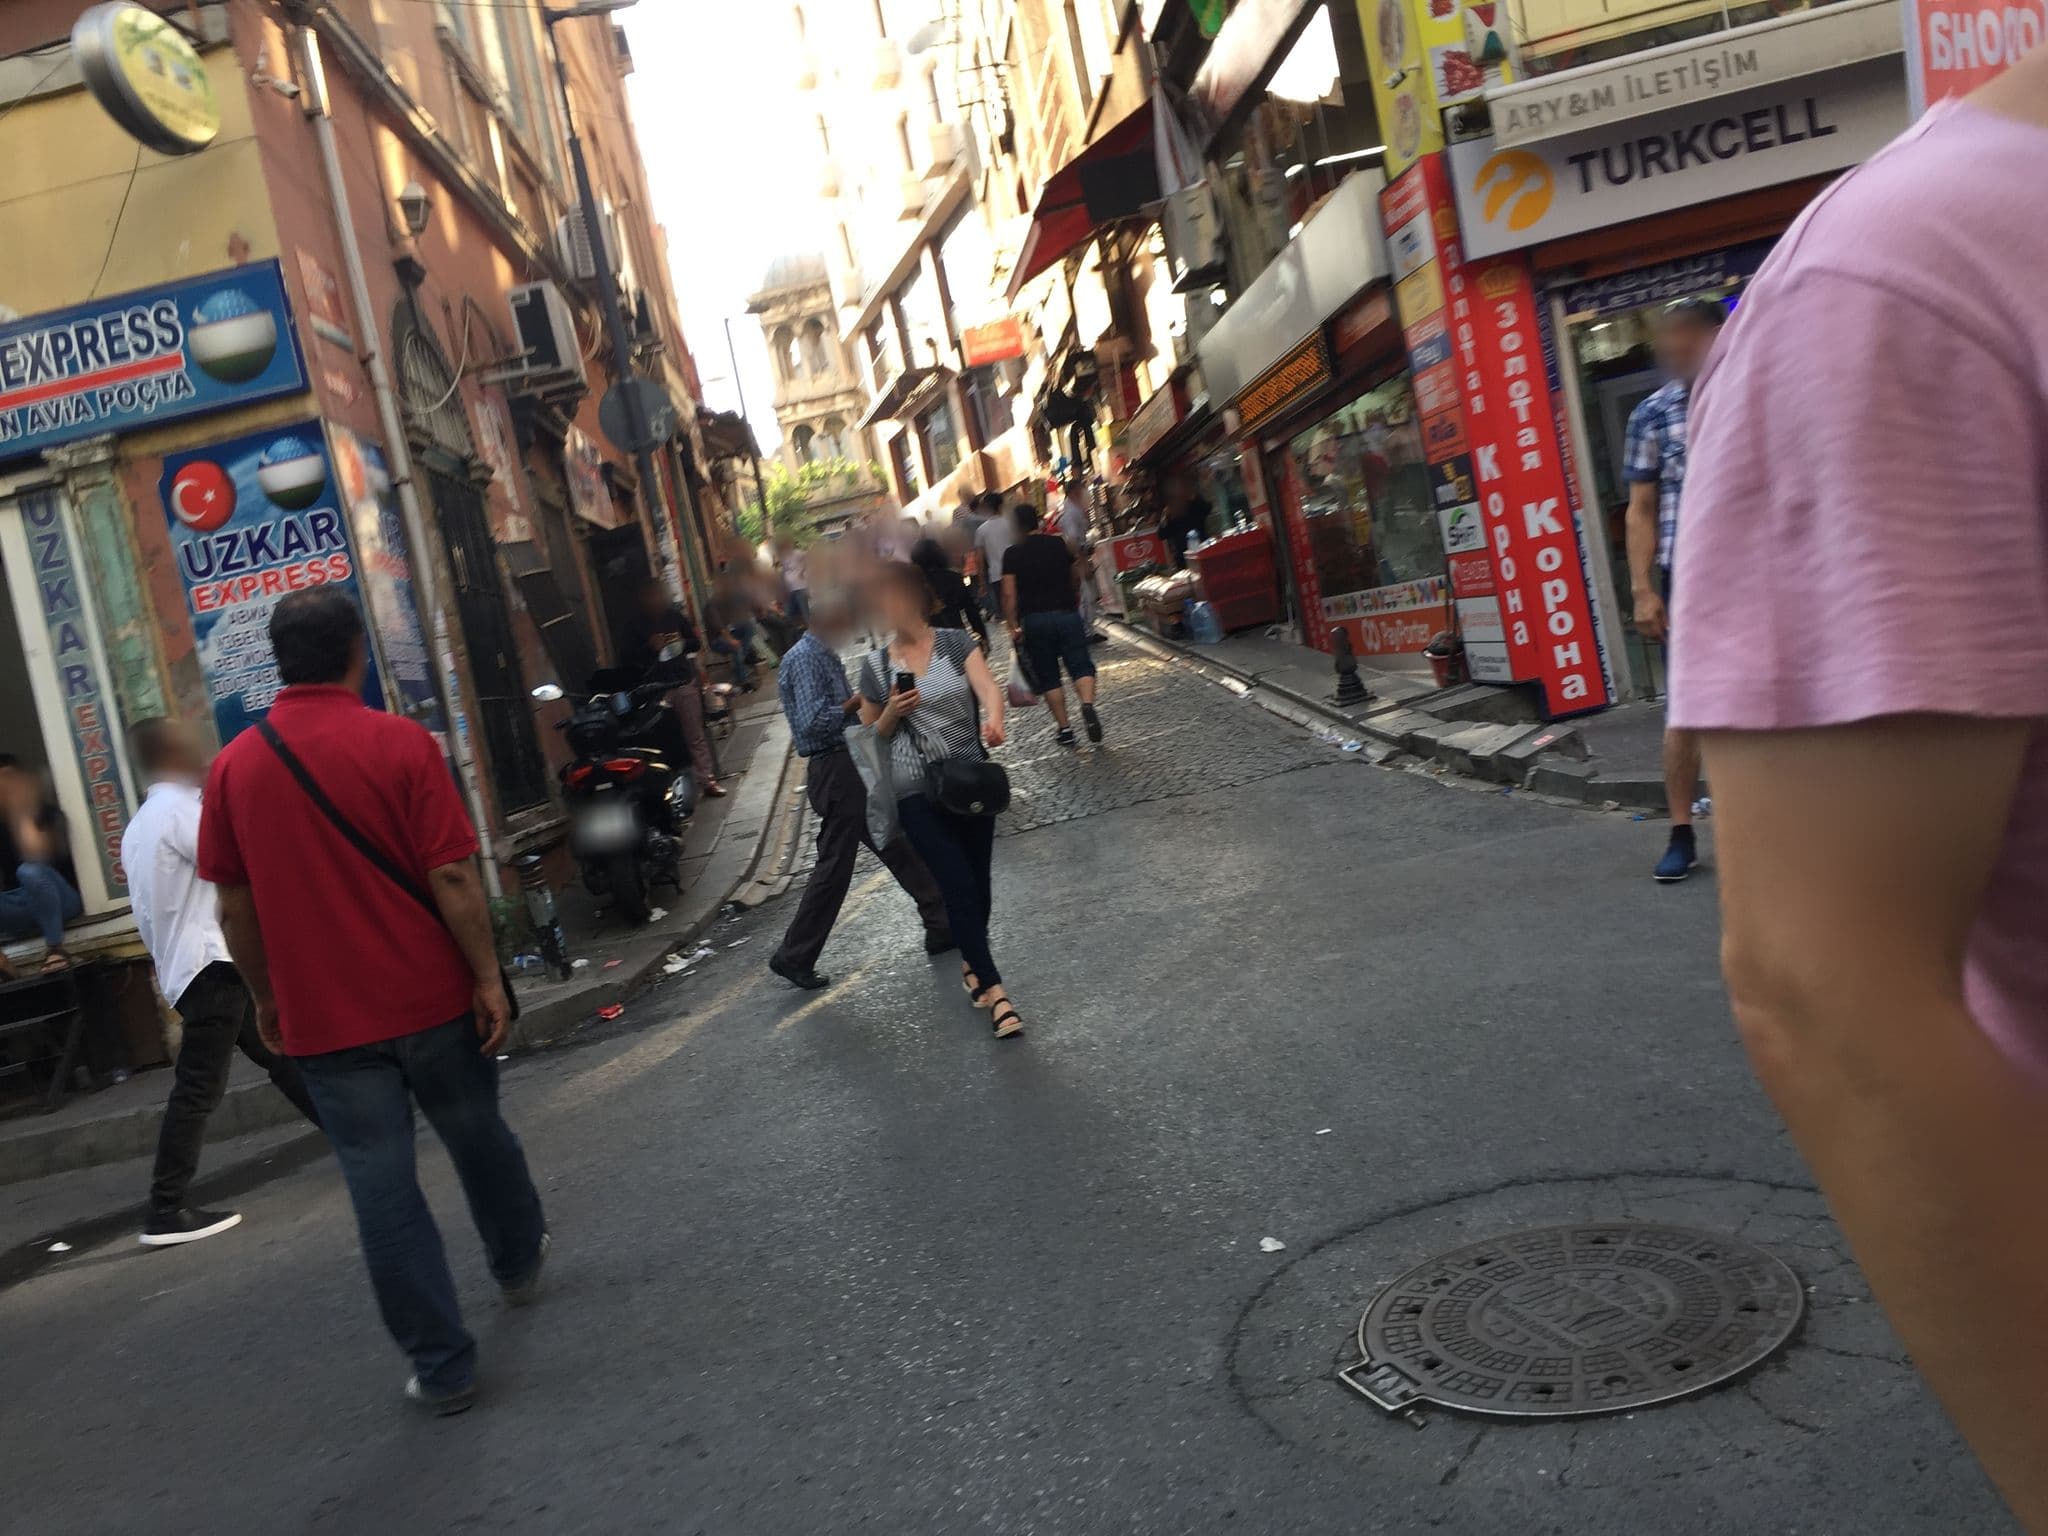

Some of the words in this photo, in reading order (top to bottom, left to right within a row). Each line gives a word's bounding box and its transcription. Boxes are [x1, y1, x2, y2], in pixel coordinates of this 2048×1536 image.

[1507, 84, 1616, 133] ARY&M
[1624, 48, 1759, 104] İLETİŞİM
[1568, 98, 1838, 194] TURKCELL
[0, 301, 183, 388] EXPRESS
[97, 369, 196, 417] POÇTA
[1495, 301, 1543, 472] Золотая
[1521, 497, 1588, 700] Корона
[180, 507, 347, 582] UZKAR
[189, 551, 353, 614] EXPRESS
[1475, 443, 1530, 647] Корона
[27, 490, 93, 699] UZKAR
